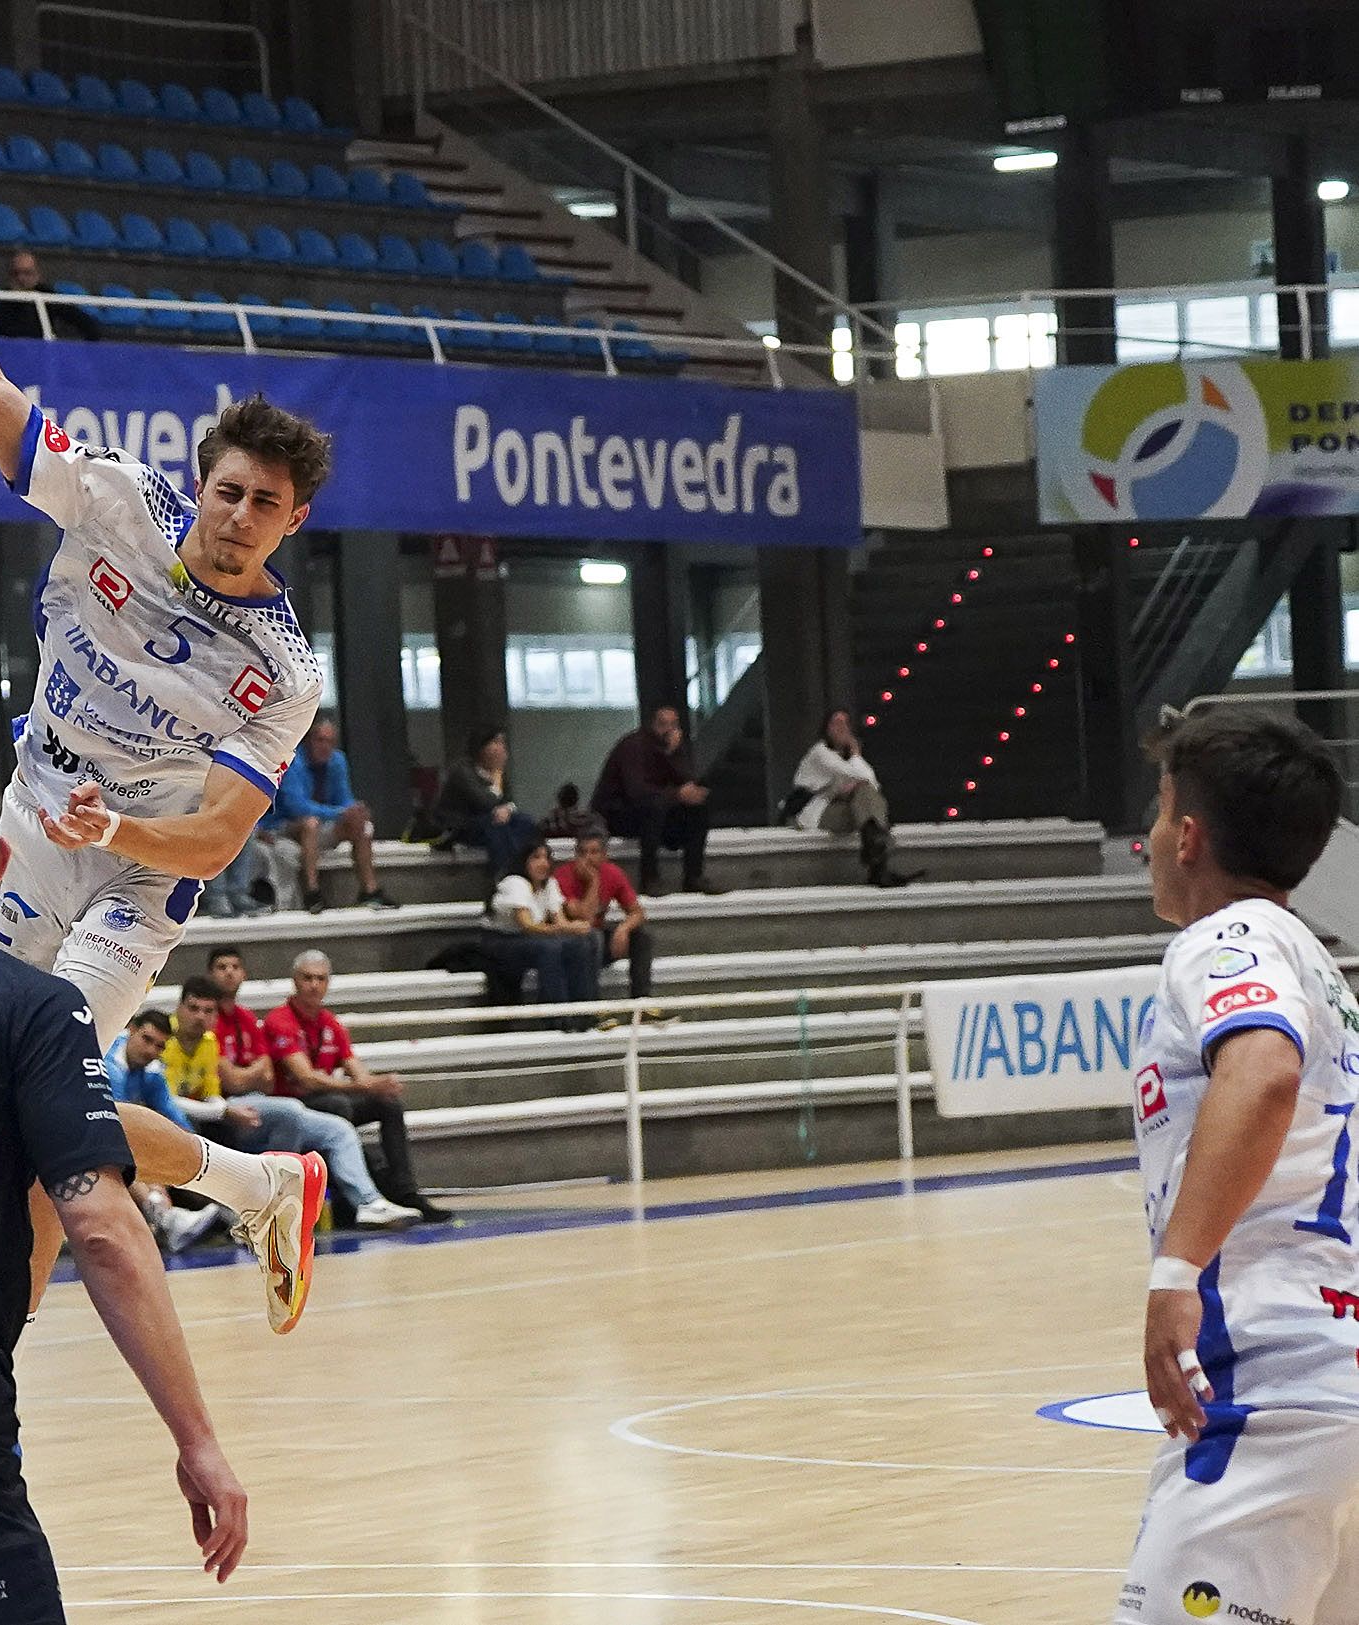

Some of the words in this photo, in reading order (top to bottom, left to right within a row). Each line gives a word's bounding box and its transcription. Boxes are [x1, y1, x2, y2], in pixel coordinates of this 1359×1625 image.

[453, 404, 800, 517] Pontevedra
[144, 615, 217, 665] 5
[82, 940, 139, 976] PONTEVEDRA
[85, 932, 143, 968] DEPUTACIÓN
